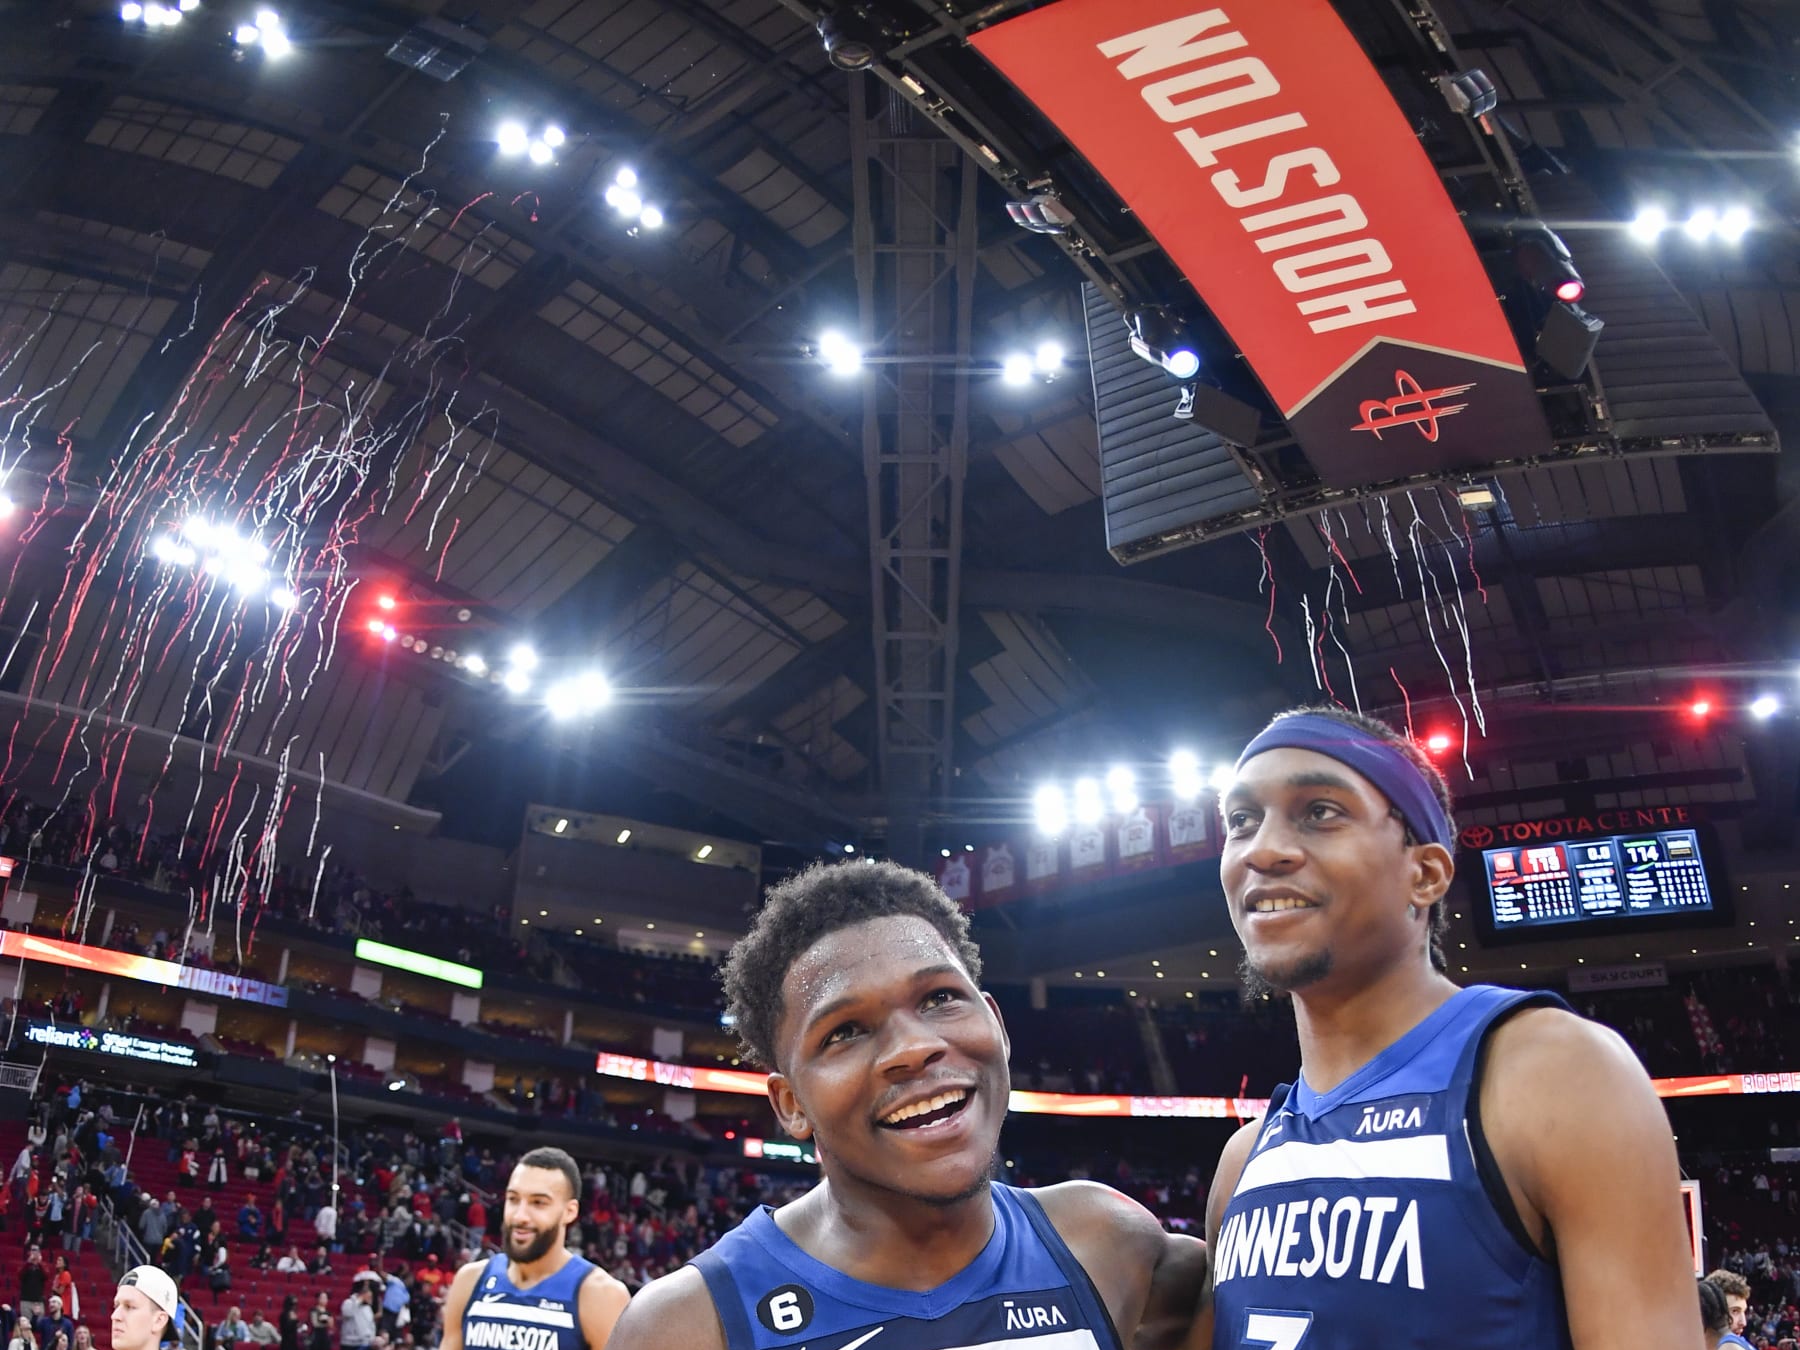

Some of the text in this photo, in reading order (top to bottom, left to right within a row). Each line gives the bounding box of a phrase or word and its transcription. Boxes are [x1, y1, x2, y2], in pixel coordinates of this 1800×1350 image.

[1096, 7, 1417, 335] HOUSTON
[1498, 817, 1594, 841] TOYOTA
[1627, 846, 1659, 862] 114
[29, 1025, 81, 1048] reliant
[1212, 1195, 1425, 1290] MINNESOTA
[485, 1276, 497, 1289] 6
[768, 1291, 804, 1331] 6
